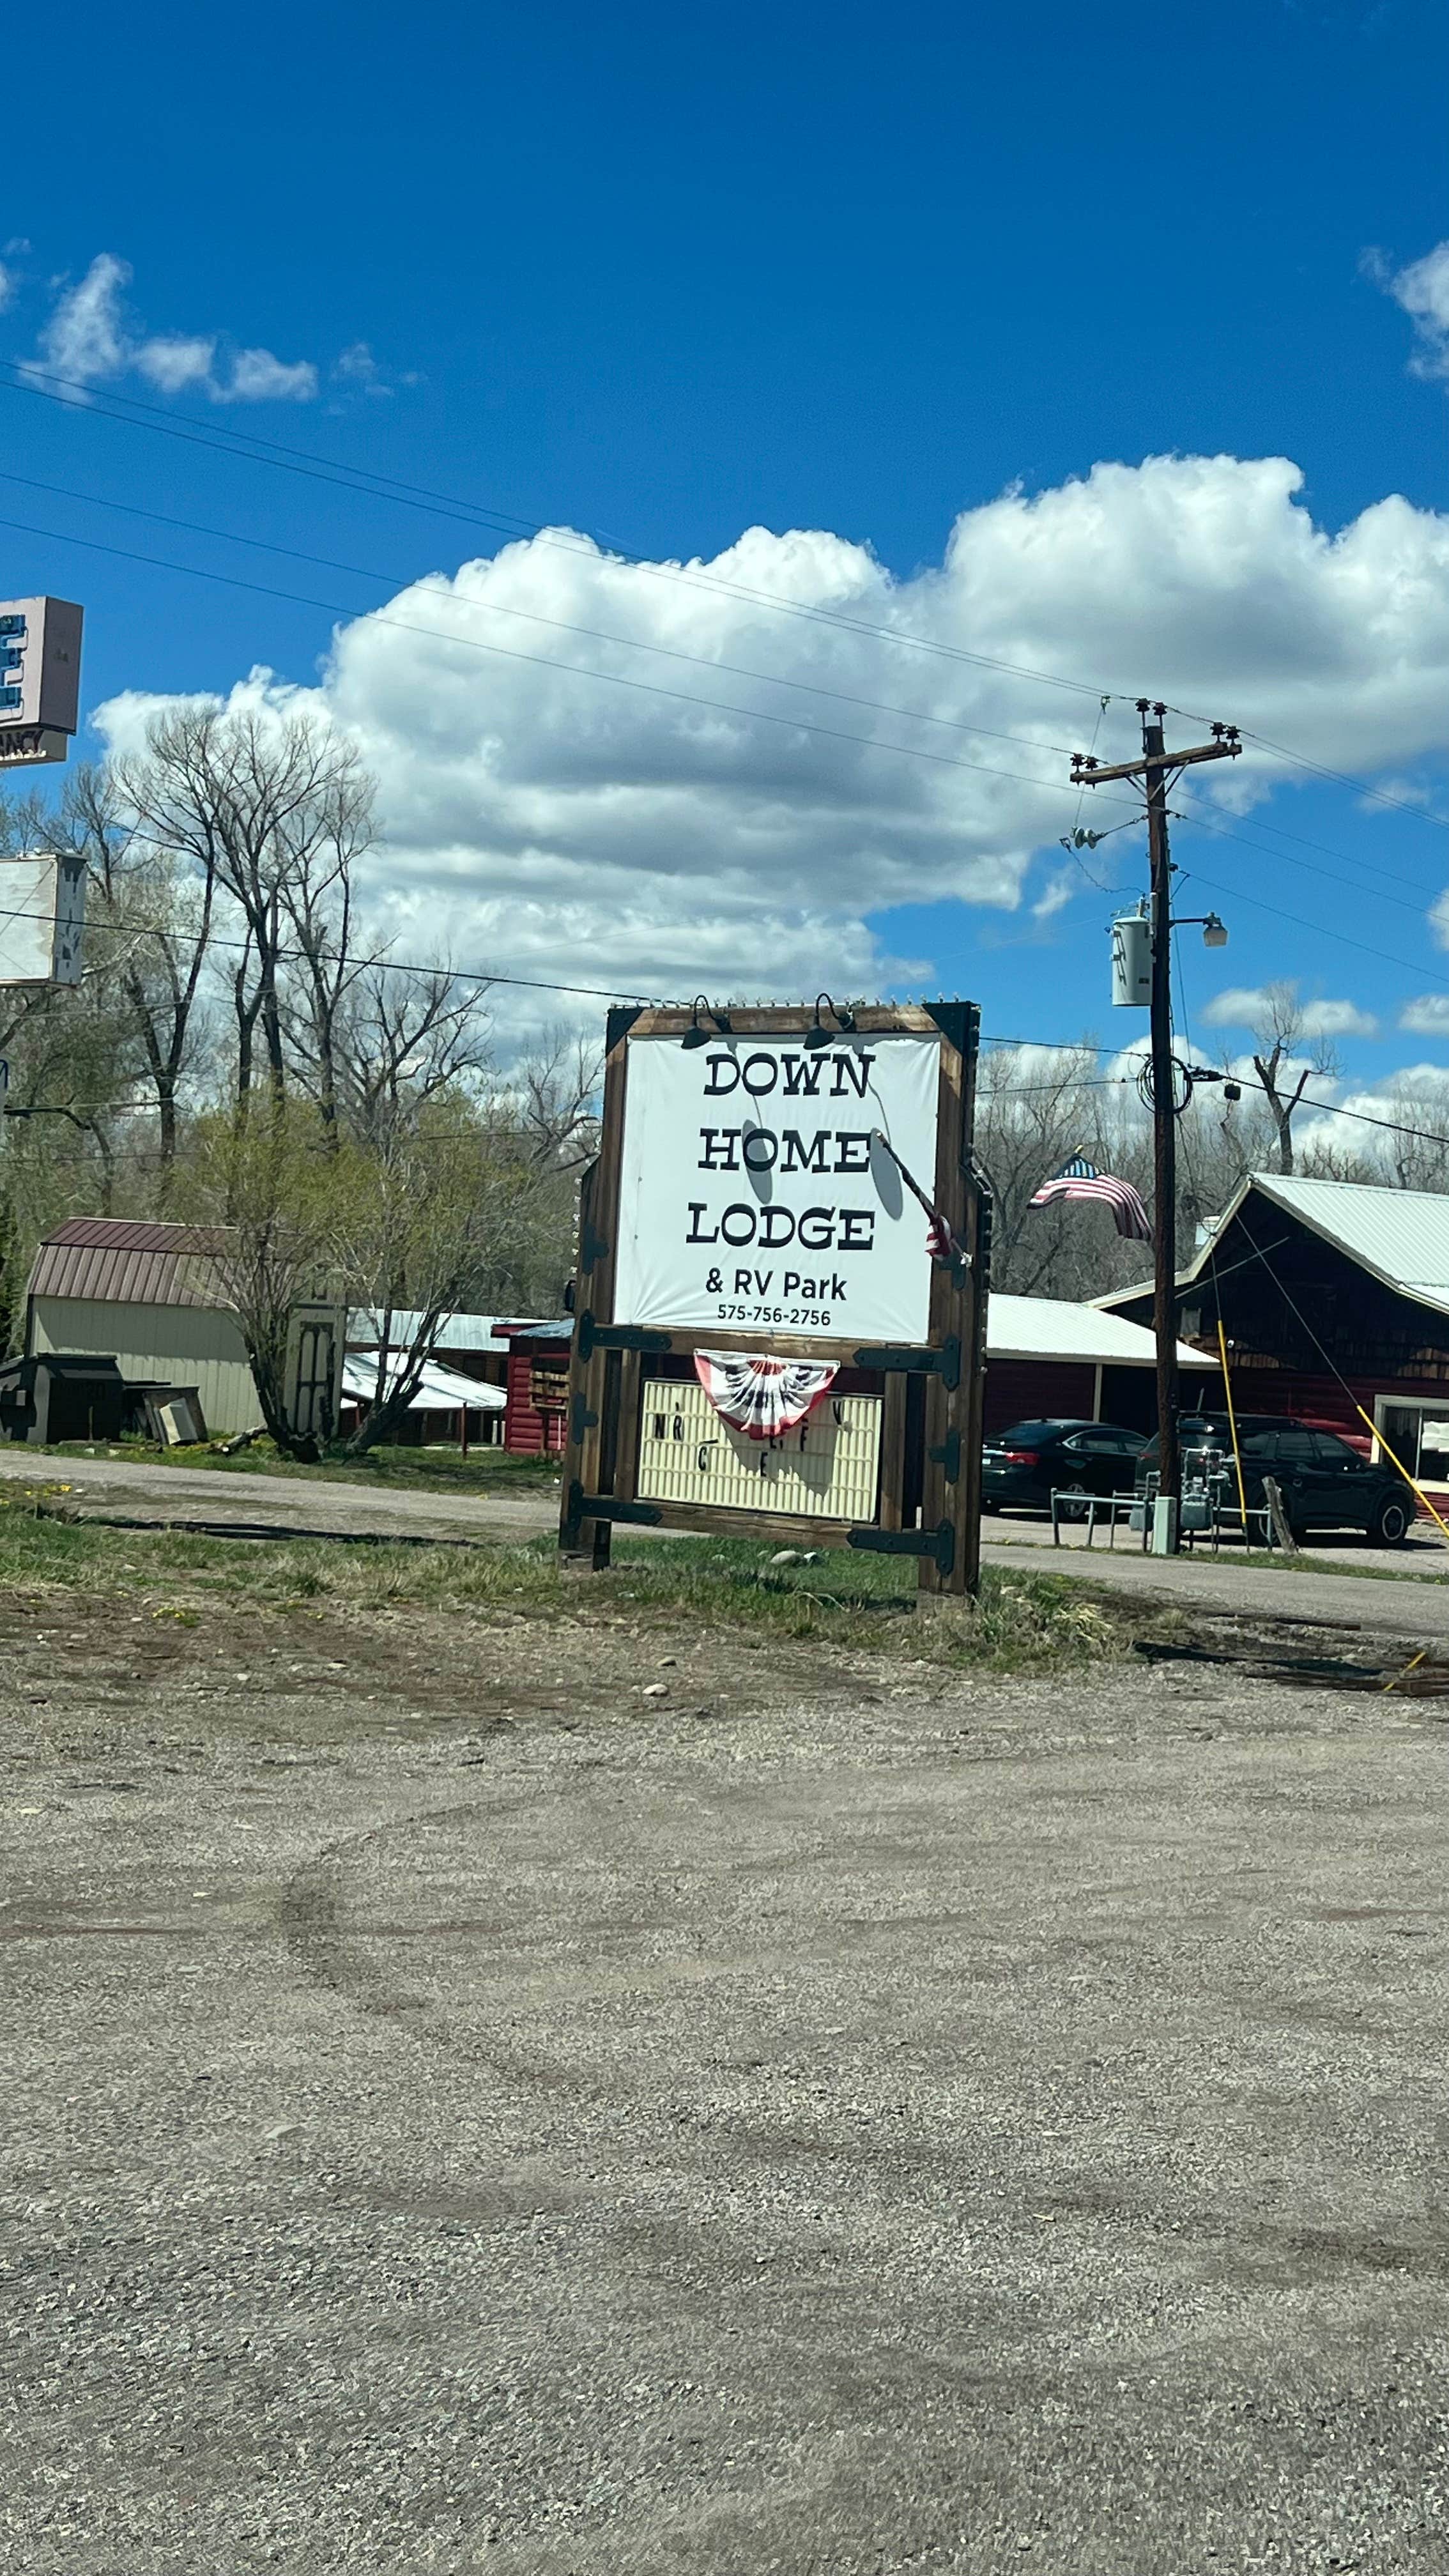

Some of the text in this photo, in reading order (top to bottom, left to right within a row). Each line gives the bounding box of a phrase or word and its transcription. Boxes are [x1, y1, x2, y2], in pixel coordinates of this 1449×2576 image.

[0, 729, 44, 756] NCY
[703, 1052, 875, 1098] DOWN
[698, 1128, 872, 1174] HOME
[686, 1202, 875, 1251] LODGE
[705, 1267, 847, 1301] & RV Park
[717, 1304, 831, 1326] 575-756-2756
